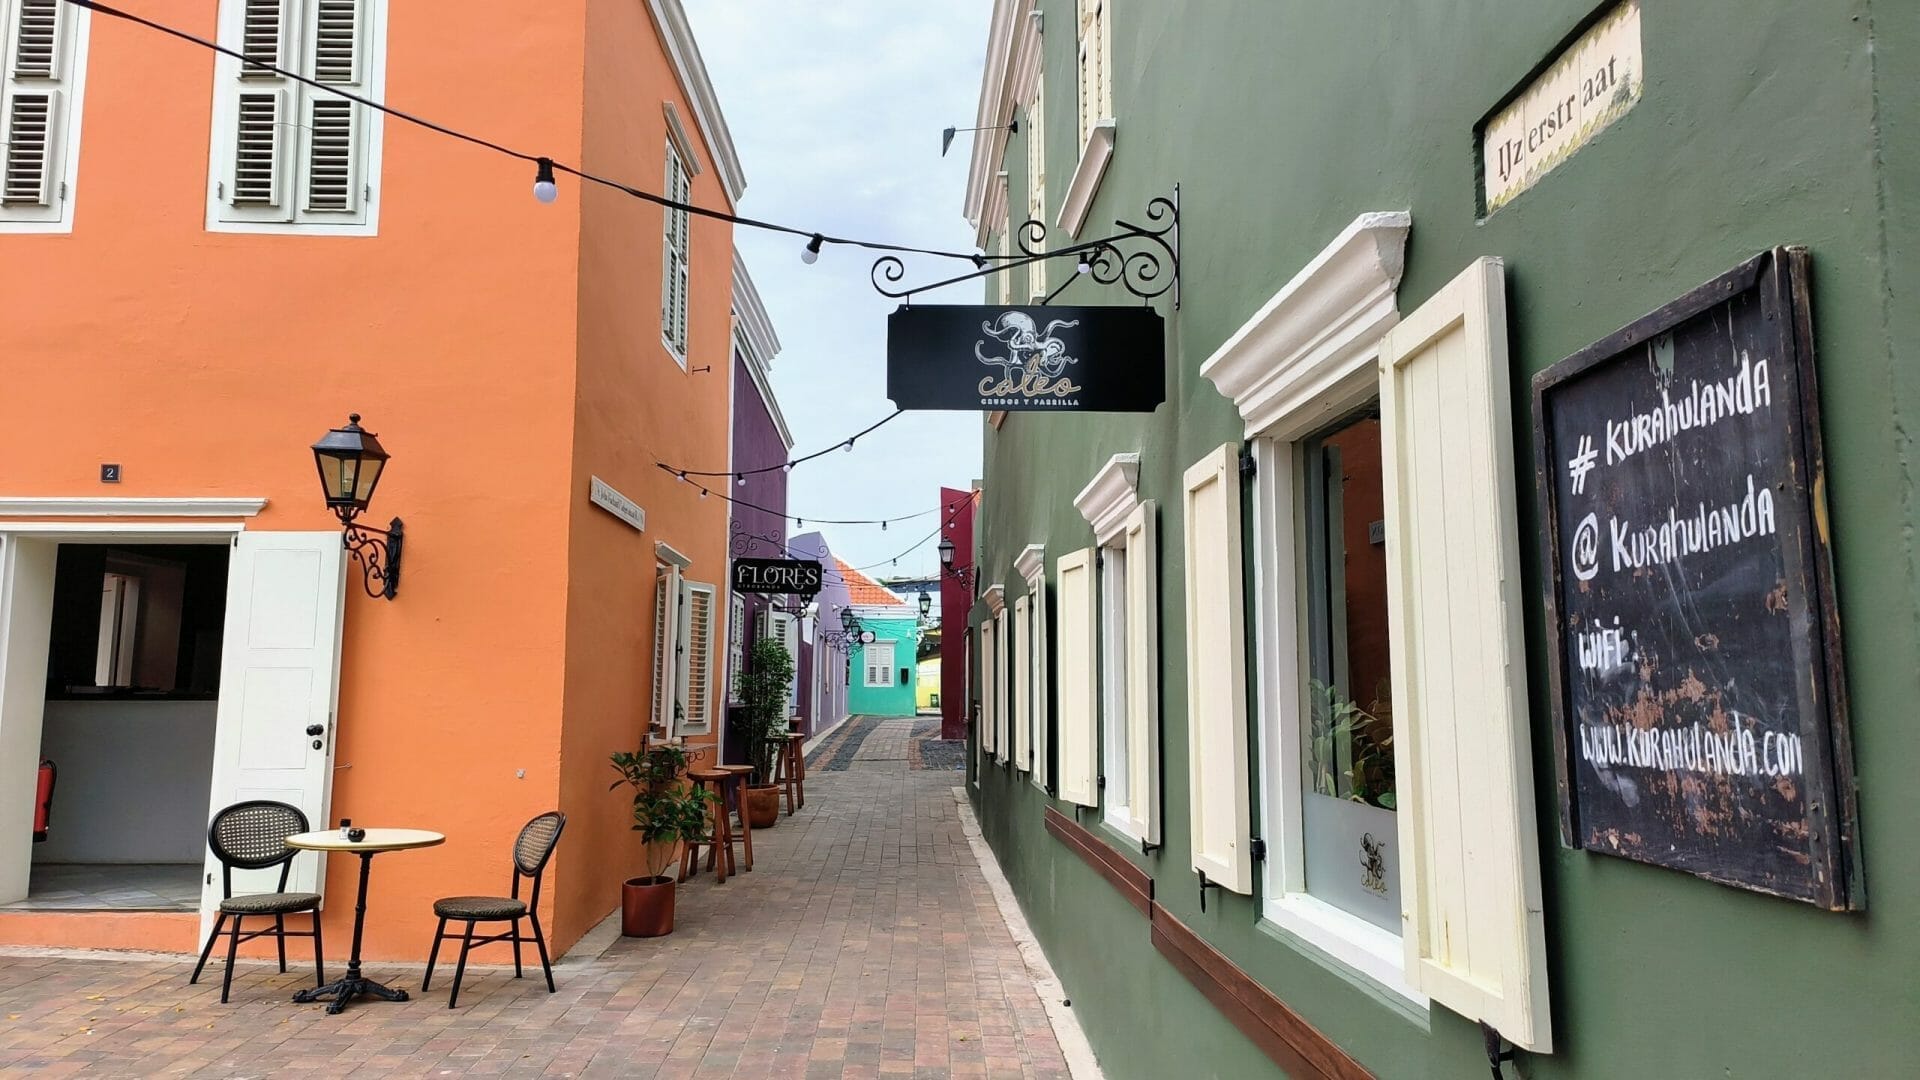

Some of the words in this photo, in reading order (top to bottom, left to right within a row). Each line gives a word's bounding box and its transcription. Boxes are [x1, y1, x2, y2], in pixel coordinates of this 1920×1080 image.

[978, 353, 1082, 397] caleo
[1033, 398, 1080, 406] PARRILLA
[106, 467, 114, 478] 2
